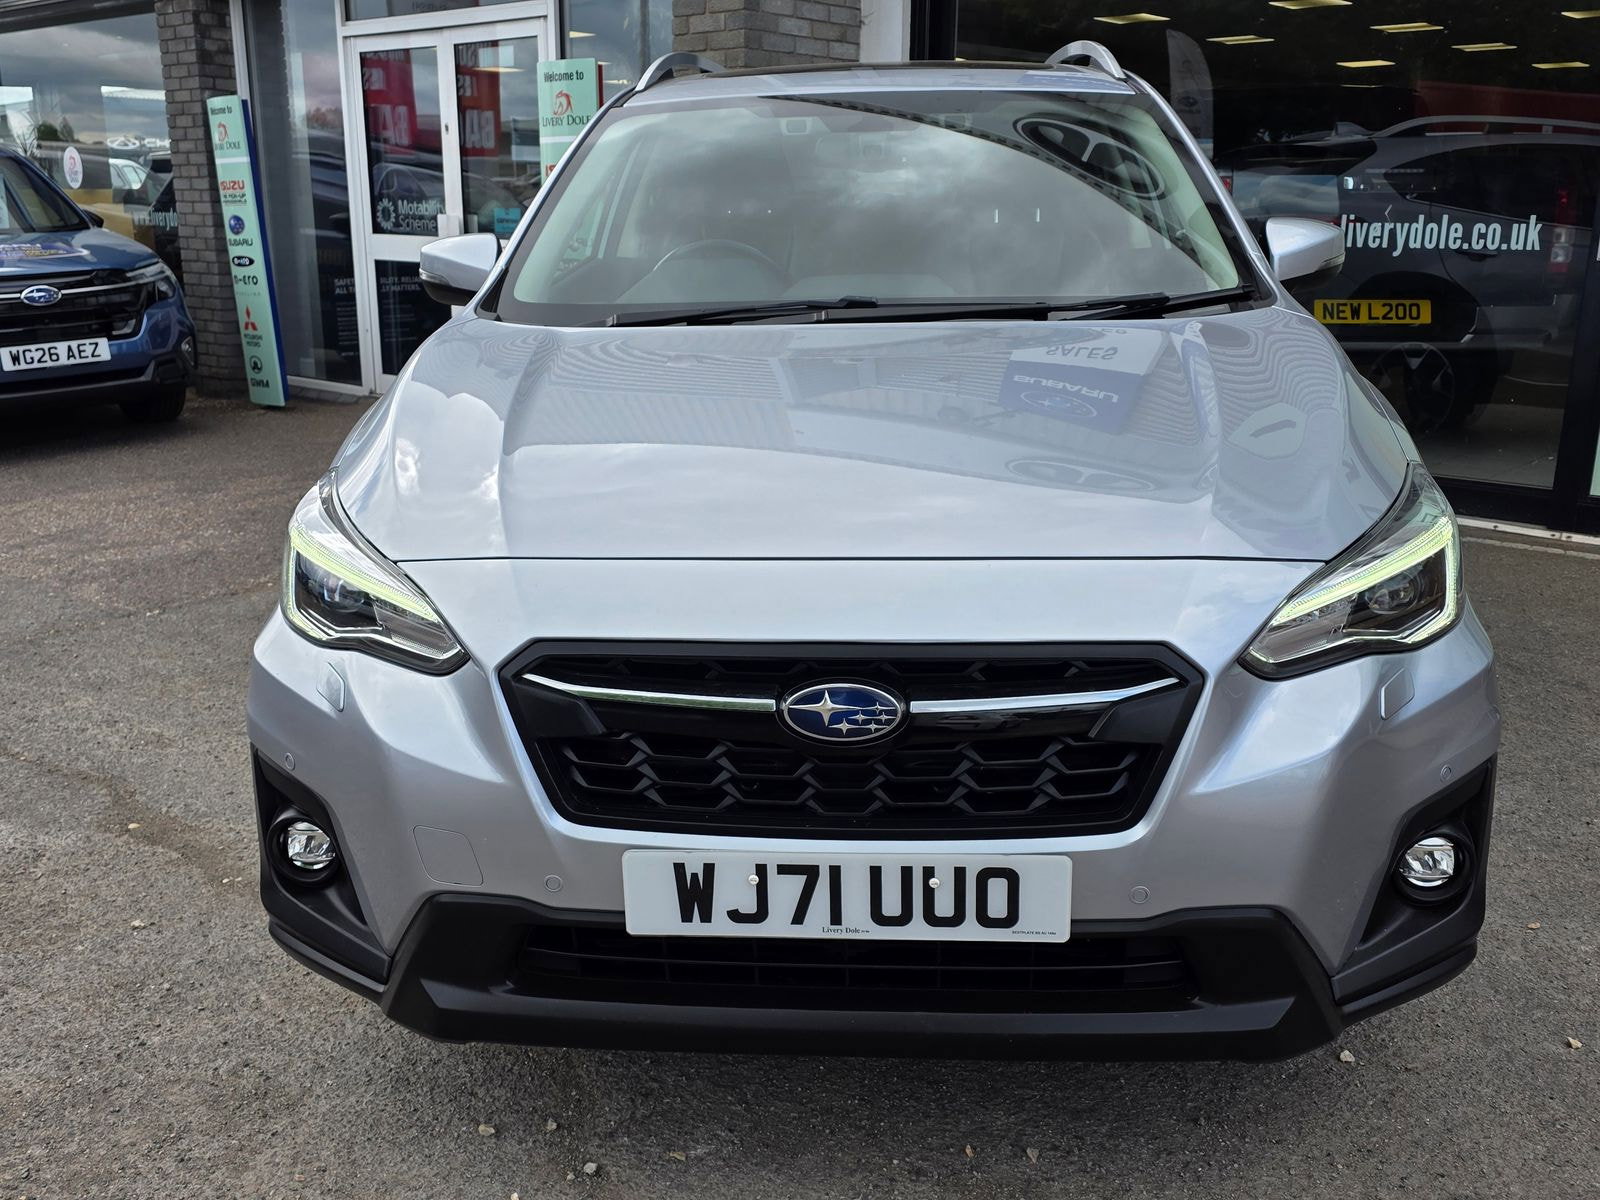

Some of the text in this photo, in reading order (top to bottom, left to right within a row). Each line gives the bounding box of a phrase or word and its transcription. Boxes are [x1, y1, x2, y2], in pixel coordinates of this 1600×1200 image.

[544, 69, 585, 82] Welcome to
[542, 116, 565, 127] LIVERY
[399, 199, 446, 215] Motability
[399, 216, 437, 231] Scheme
[1322, 302, 1421, 321] NEW L200
[9, 342, 102, 367] WG26 AEZ
[673, 862, 1020, 929] WJ71 UUO
[822, 926, 843, 935] Livery
